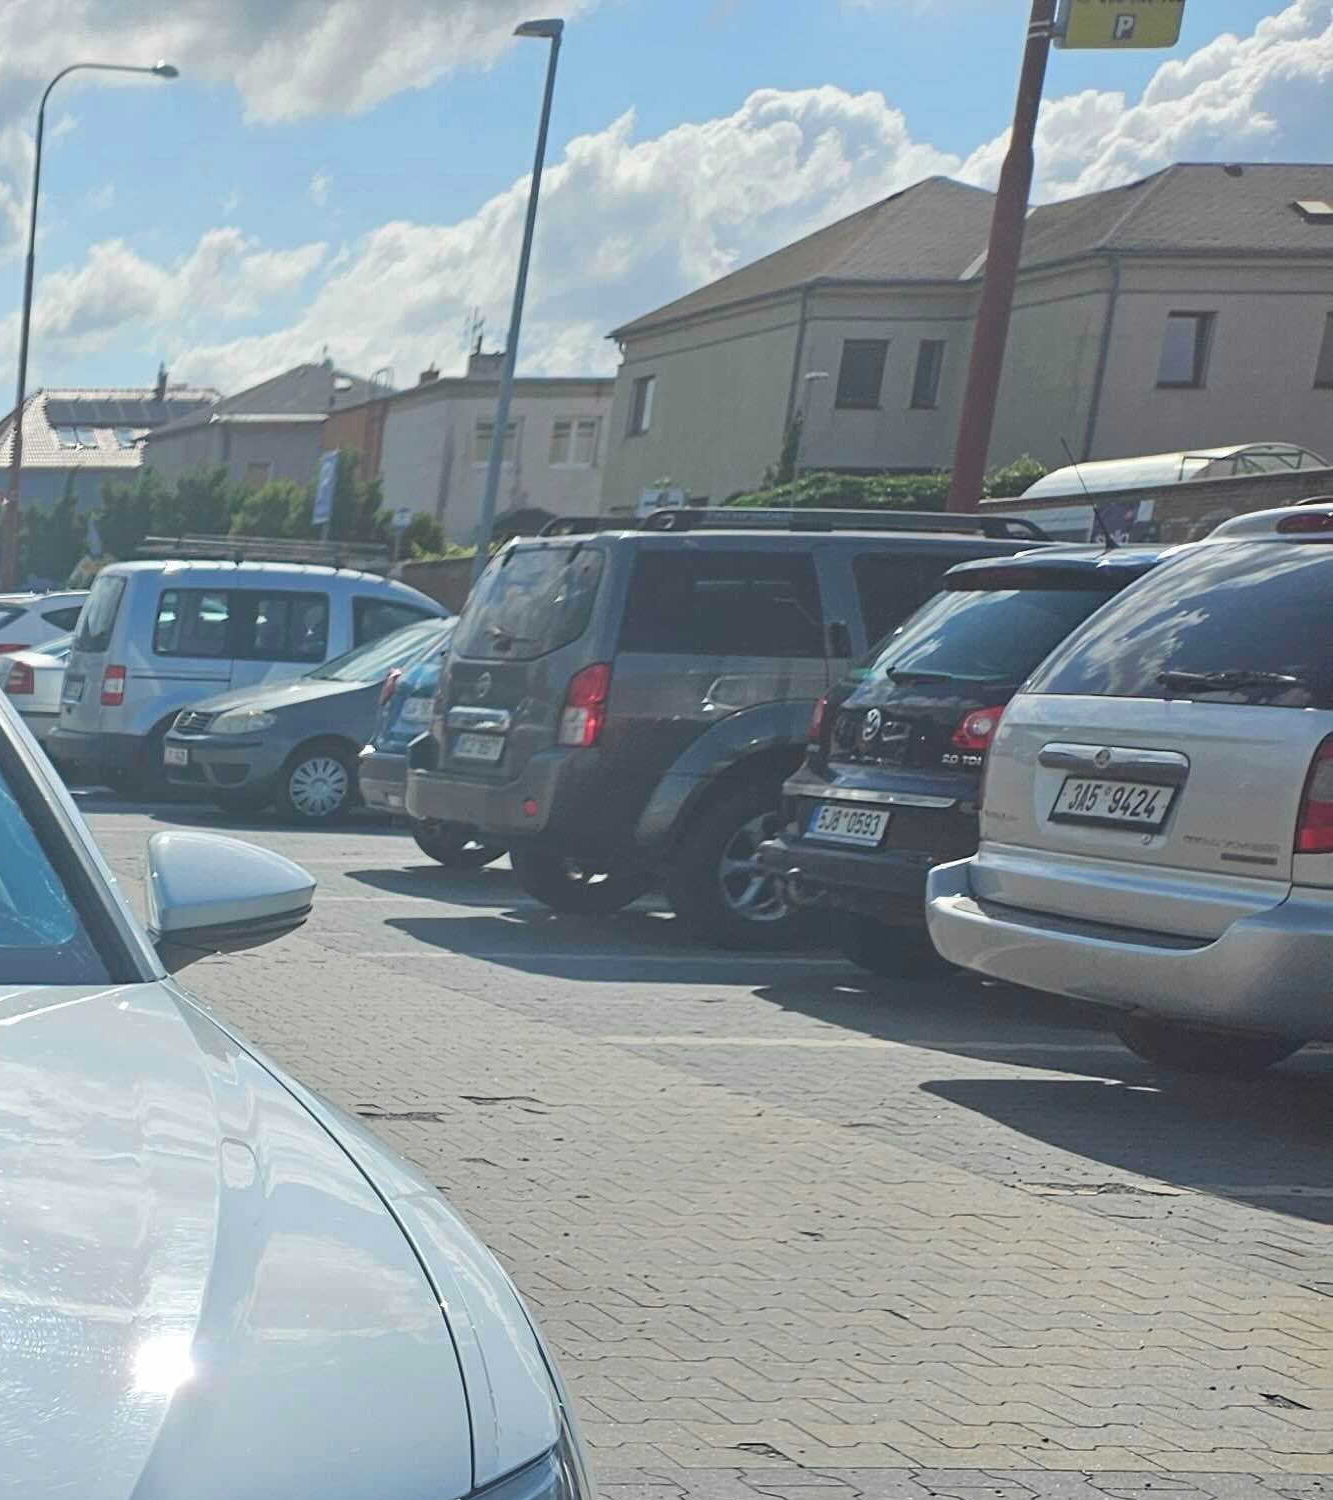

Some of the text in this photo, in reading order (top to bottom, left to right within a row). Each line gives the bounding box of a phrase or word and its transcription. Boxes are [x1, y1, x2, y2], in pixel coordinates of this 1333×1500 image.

[1068, 783, 1162, 819] 3A5 9424
[846, 811, 882, 836] 0593
